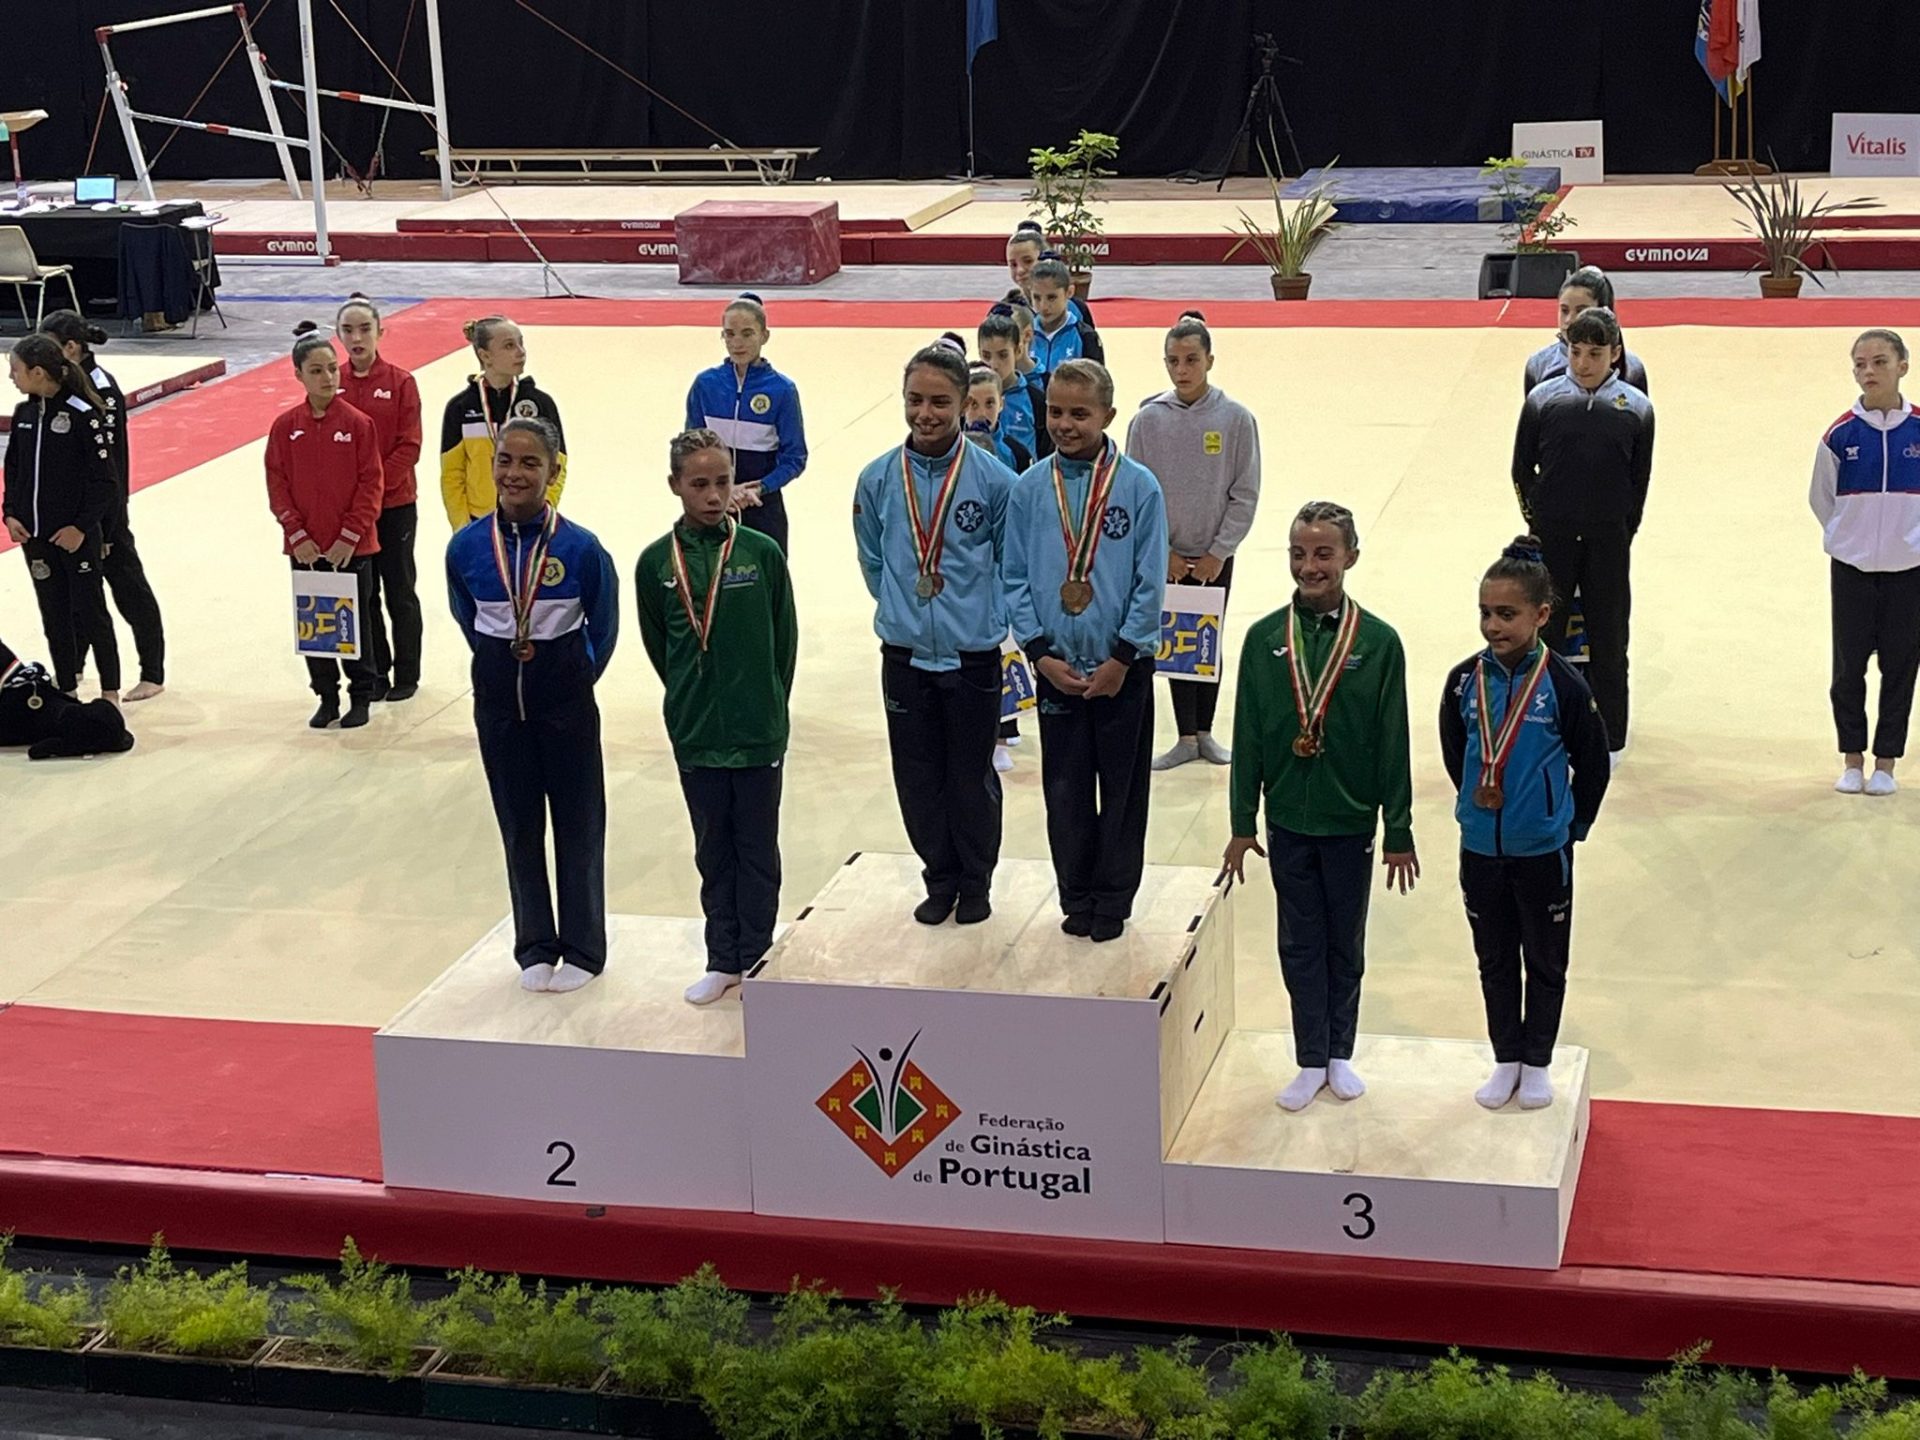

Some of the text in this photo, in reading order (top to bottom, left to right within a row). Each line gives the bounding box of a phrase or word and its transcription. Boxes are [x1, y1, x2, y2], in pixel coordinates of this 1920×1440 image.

[1577, 148, 1593, 157] TV
[1847, 131, 1907, 155] Vitalis
[267, 240, 332, 252] GYMNO
[638, 243, 679, 256] GYMN
[1625, 247, 1709, 262] GYMNOVA
[979, 1113, 1065, 1132] Federação
[945, 1134, 1092, 1161] de Ginástica
[546, 1141, 577, 1187] 2
[913, 1158, 1091, 1200] de Portugal
[1342, 1192, 1376, 1240] 3
